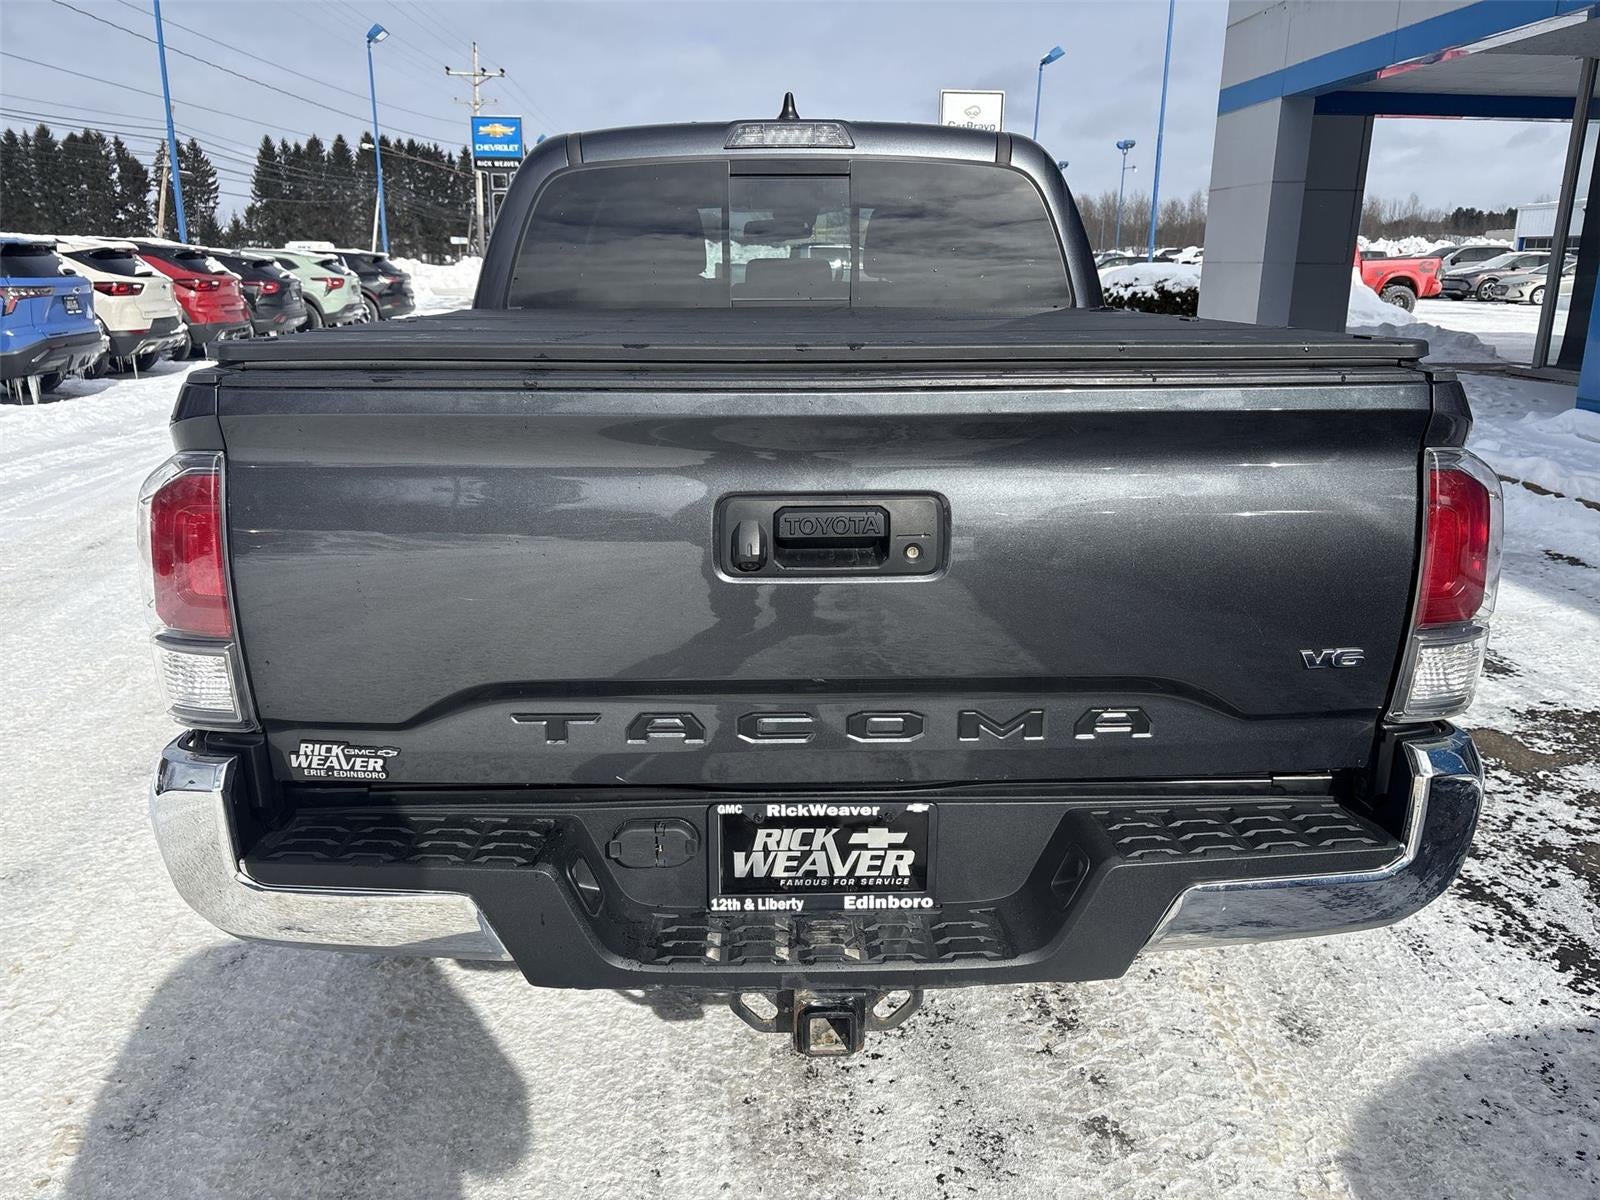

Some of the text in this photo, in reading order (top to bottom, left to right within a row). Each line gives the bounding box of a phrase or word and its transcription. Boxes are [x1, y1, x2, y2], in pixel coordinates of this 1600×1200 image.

[475, 144, 519, 152] CHEVROLET
[785, 515, 881, 536] TOYOTA
[1300, 646, 1365, 670] V6
[510, 707, 1153, 745] TACOMA
[299, 743, 376, 757] RICK GMC
[290, 755, 384, 771] WEAVER
[717, 804, 743, 815] GMC
[766, 803, 880, 817] RickWeaver
[751, 828, 841, 852] RICK
[733, 849, 916, 879] WEAVER
[779, 876, 911, 887] FAMOUS FOR SERVICE
[711, 897, 804, 912] 12th & Liberty
[843, 894, 934, 910] Edinboro
